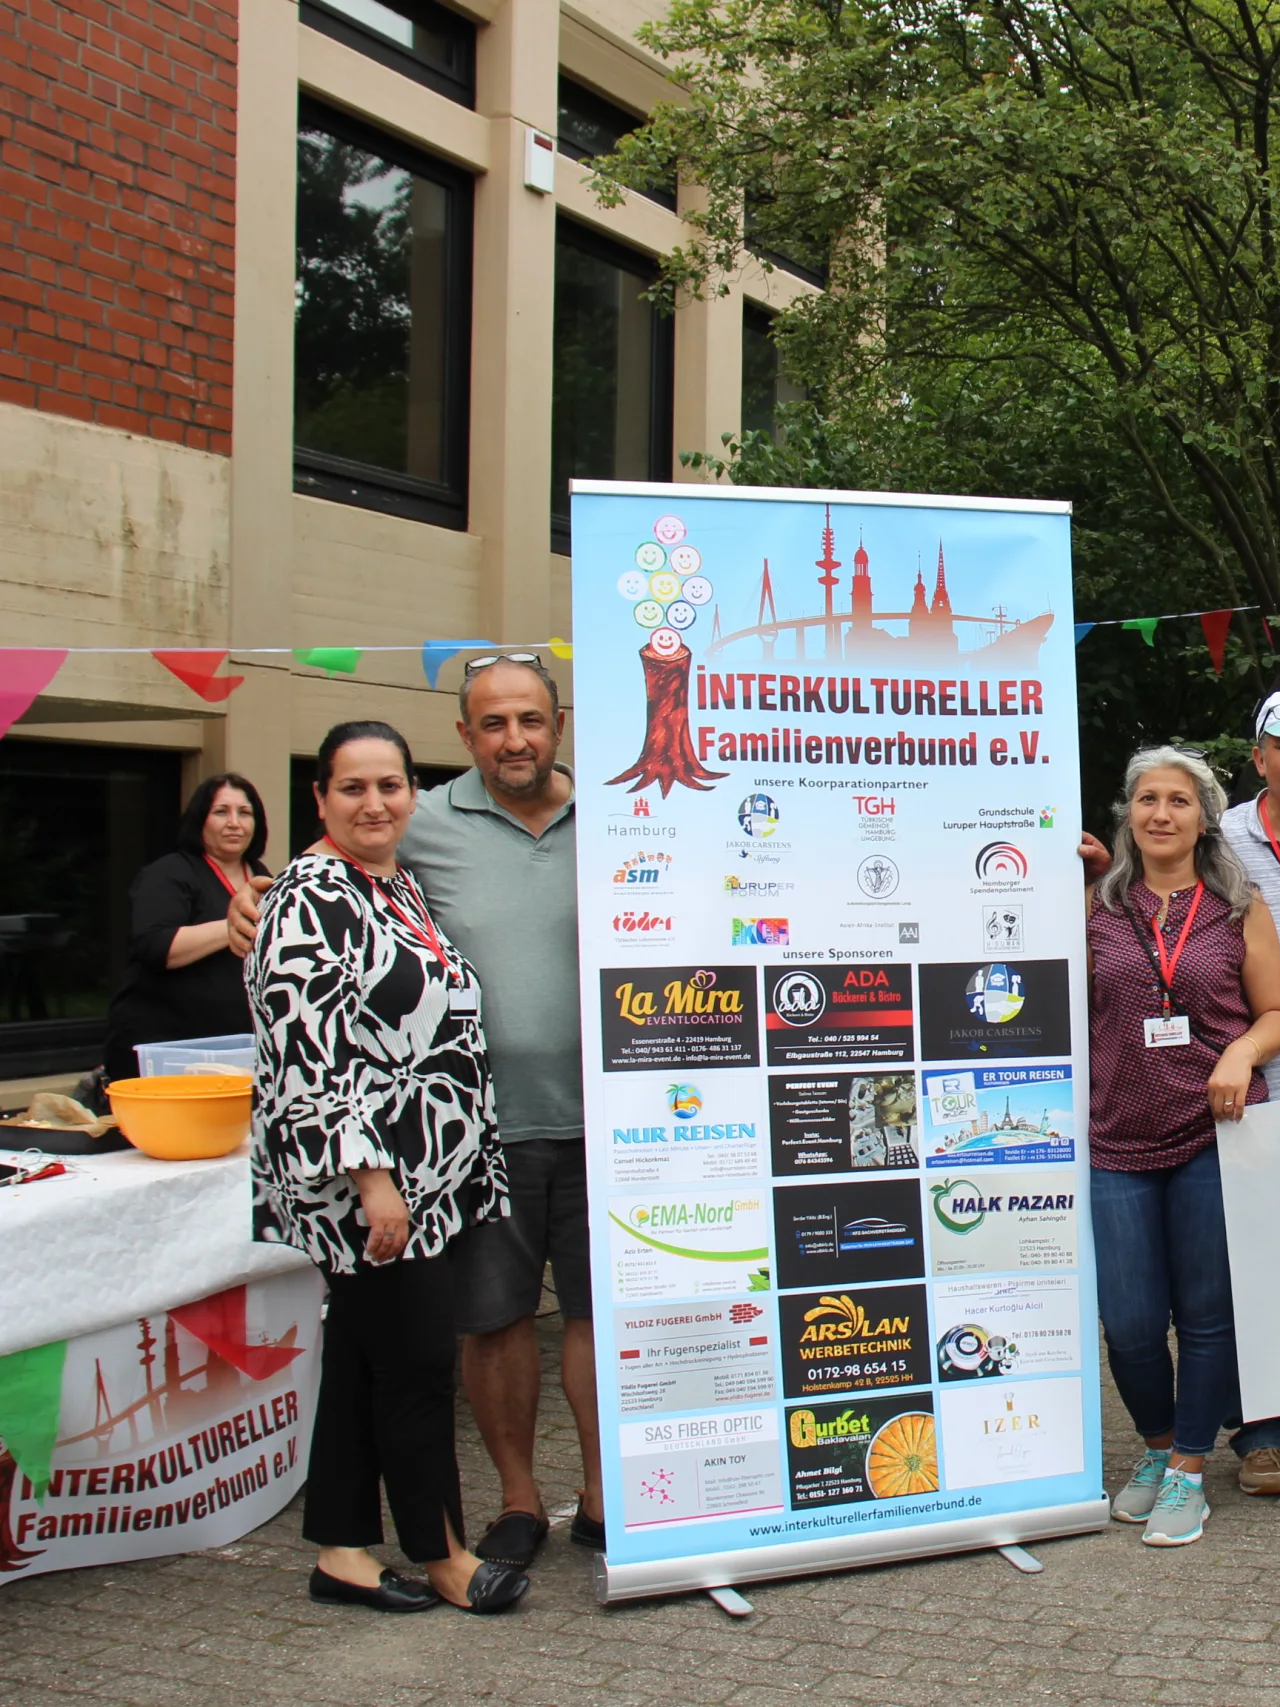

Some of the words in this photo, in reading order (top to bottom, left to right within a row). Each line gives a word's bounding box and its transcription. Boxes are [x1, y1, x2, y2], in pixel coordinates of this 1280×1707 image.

[698, 726, 977, 766] Familienverbund
[990, 730, 1050, 765] e.V.
[754, 777, 795, 789] unsere
[799, 776, 929, 792] Koorparationpartner
[852, 796, 896, 816] TGH
[978, 807, 1035, 817] Grundschule
[861, 815, 894, 823] TÜRKISCHE
[943, 821, 978, 831] Luruper
[980, 820, 1035, 830] Hauptstraße
[608, 825, 677, 839] Hamburg
[858, 822, 890, 830] GEMEINDE
[726, 841, 751, 849] JAKOB
[752, 841, 792, 849] CARSTENS
[753, 854, 781, 864] Stiftung
[613, 868, 660, 884] asm
[731, 882, 795, 891] LURUPER
[970, 886, 1034, 894] Spendenparlament
[982, 880, 1021, 888] Hamburger
[731, 889, 780, 898] FORUM
[612, 911, 677, 933] töder
[783, 950, 825, 960] unsere
[828, 948, 893, 961] Sponsoren
[843, 970, 890, 988] ADA
[615, 982, 658, 1026] La
[664, 980, 744, 1015] Mira
[832, 990, 868, 1004] Bäckerei
[869, 991, 877, 1002] &
[878, 989, 901, 1003] Bistro
[646, 1014, 743, 1026] EVENTLOCATION
[631, 1036, 676, 1045] Essenerstraße
[685, 1036, 705, 1044] 22419
[705, 1035, 732, 1044] Hamburg
[808, 1034, 823, 1042] Tel.:
[824, 1034, 838, 1042] 040
[842, 1034, 856, 1042] 525
[870, 1033, 879, 1041] 54
[950, 1029, 984, 1040] JAKOB
[986, 1027, 1042, 1038] CARSTENS
[621, 1047, 635, 1055] Tel.:
[635, 1046, 652, 1055] 040/
[652, 1046, 664, 1054] 943
[674, 1045, 686, 1053] 411
[709, 1044, 721, 1052] 486
[722, 1044, 730, 1052] 31
[731, 1043, 742, 1051] 137
[786, 1050, 833, 1060] Elbgaustraße
[835, 1050, 849, 1059] 112,
[850, 1049, 871, 1058] 22547
[872, 1048, 904, 1058] Hamburg
[612, 1055, 682, 1064] www.la-mira-event.de
[685, 1053, 752, 1063] info@la-mira-event.de
[983, 1072, 997, 1082] ER
[999, 1071, 1027, 1081] TOUR
[1030, 1070, 1065, 1080] REISEN
[931, 1093, 976, 1113] TOUR
[613, 1126, 668, 1145] NUR
[674, 1122, 756, 1142] REISEN
[734, 1199, 760, 1211] GmbH
[952, 1196, 1004, 1215] HALK
[1008, 1194, 1075, 1212] PAZARI
[1036, 1244, 1061, 1252] Hamburg
[948, 1282, 1002, 1293] Haushaltswaren
[964, 1306, 988, 1315] Hacer
[989, 1304, 1024, 1313] Kurtoğlu
[625, 1319, 654, 1330] YILDIZ
[656, 1317, 694, 1328] FUGEREI
[695, 1312, 722, 1323] GmbH
[800, 1316, 910, 1343] ARSLAN
[648, 1348, 661, 1358] Ihr
[664, 1339, 741, 1358] Fugenspezialist
[800, 1338, 912, 1360] WERBETECHNIK
[808, 1365, 861, 1381] 0172-98
[864, 1362, 887, 1375] 654
[891, 1360, 907, 1372] 15
[802, 1381, 853, 1393] Holstenkamp
[854, 1378, 864, 1387] 42
[875, 1376, 900, 1385] 22525
[901, 1374, 914, 1382] HH
[621, 1404, 654, 1412] Deutschland
[644, 1425, 672, 1442] SAS
[678, 1420, 718, 1438] FIBER
[723, 1415, 763, 1434] OPTIC
[789, 1409, 871, 1448] Gurbet
[984, 1414, 1041, 1435] IZER
[664, 1438, 722, 1451] DEUTSCHLAND
[724, 1436, 746, 1445] GmbH
[704, 1456, 727, 1468] AKIN
[728, 1454, 747, 1464] TOY
[795, 1468, 822, 1479] Ahmet
[16, 1453, 268, 1545] Familienverbund
[273, 1435, 298, 1480] e.V.
[828, 1488, 840, 1496] 127
[749, 1494, 982, 1538] www.interkulturellerfamilienverbund.de
